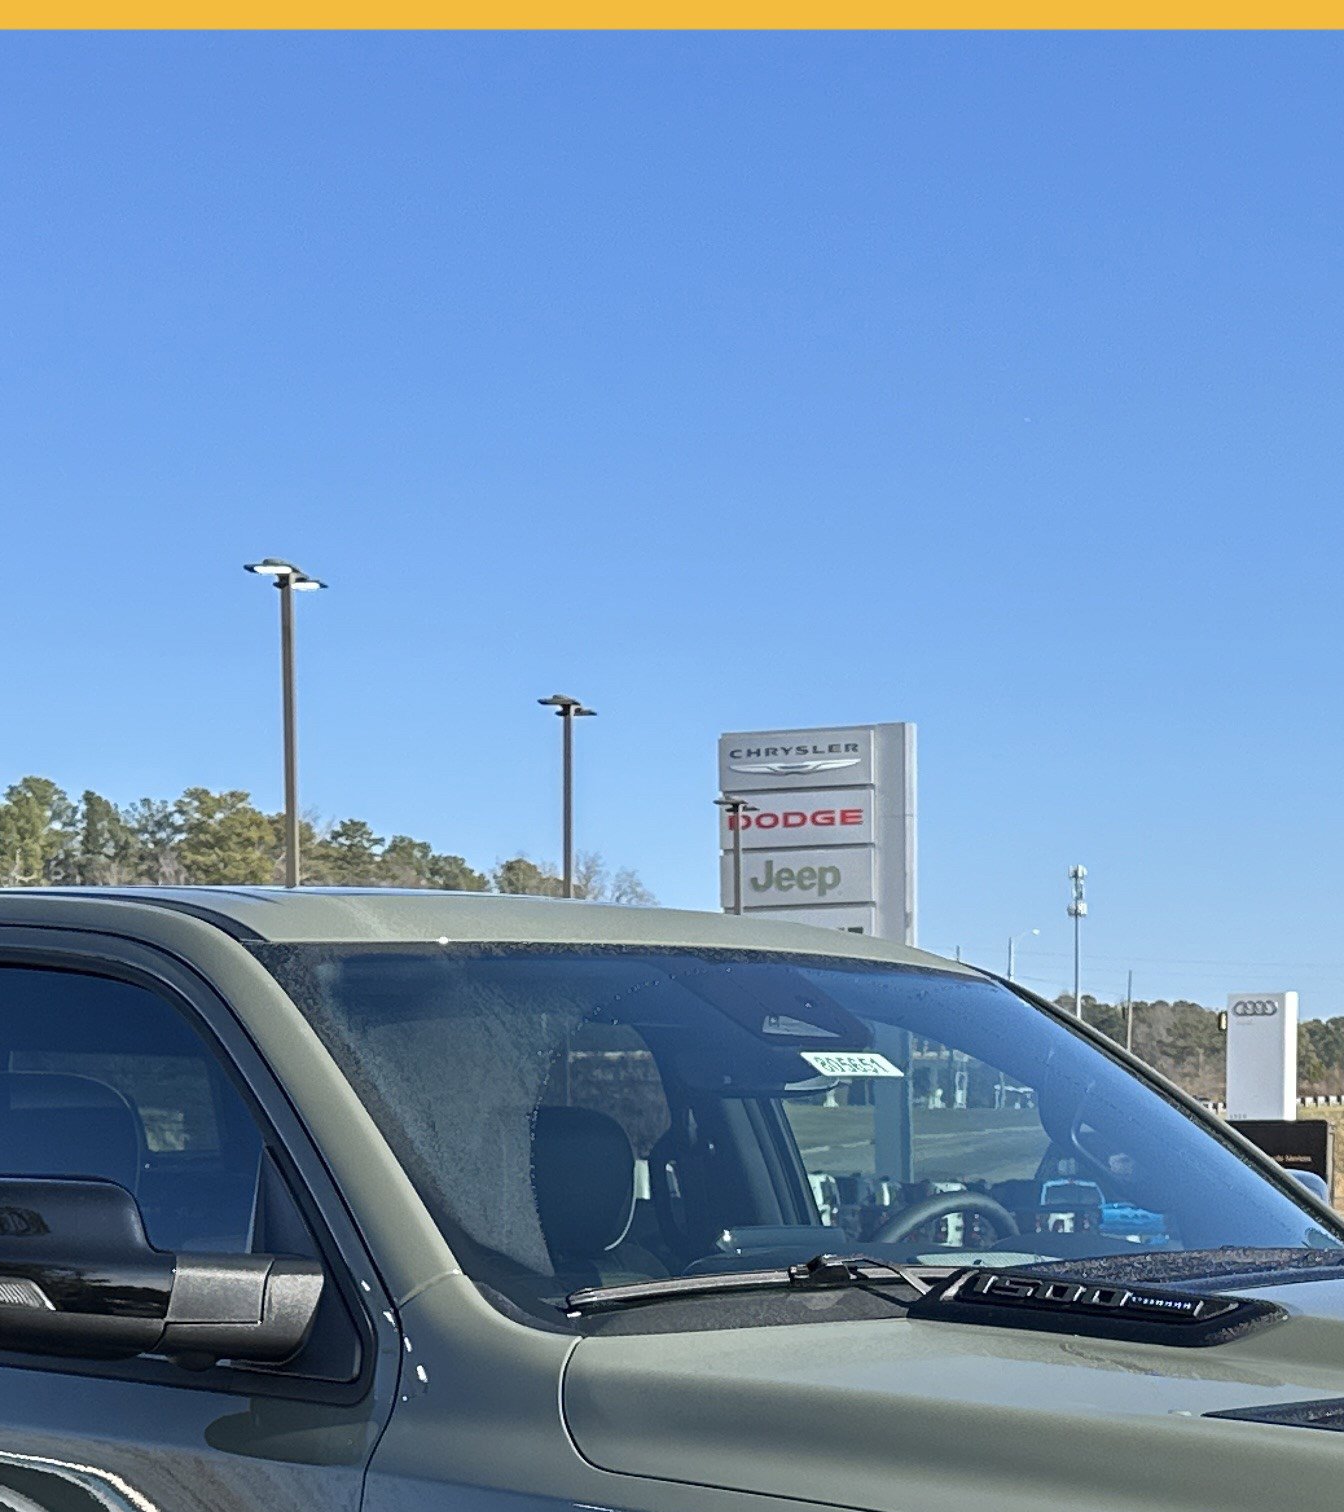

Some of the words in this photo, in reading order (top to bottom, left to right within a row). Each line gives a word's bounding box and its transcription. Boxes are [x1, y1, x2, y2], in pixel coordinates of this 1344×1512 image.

[729, 743, 859, 760] CHRYSLER
[727, 808, 864, 831] DODGE
[750, 860, 842, 897] Jeep
[973, 1273, 1130, 1307] 1500
